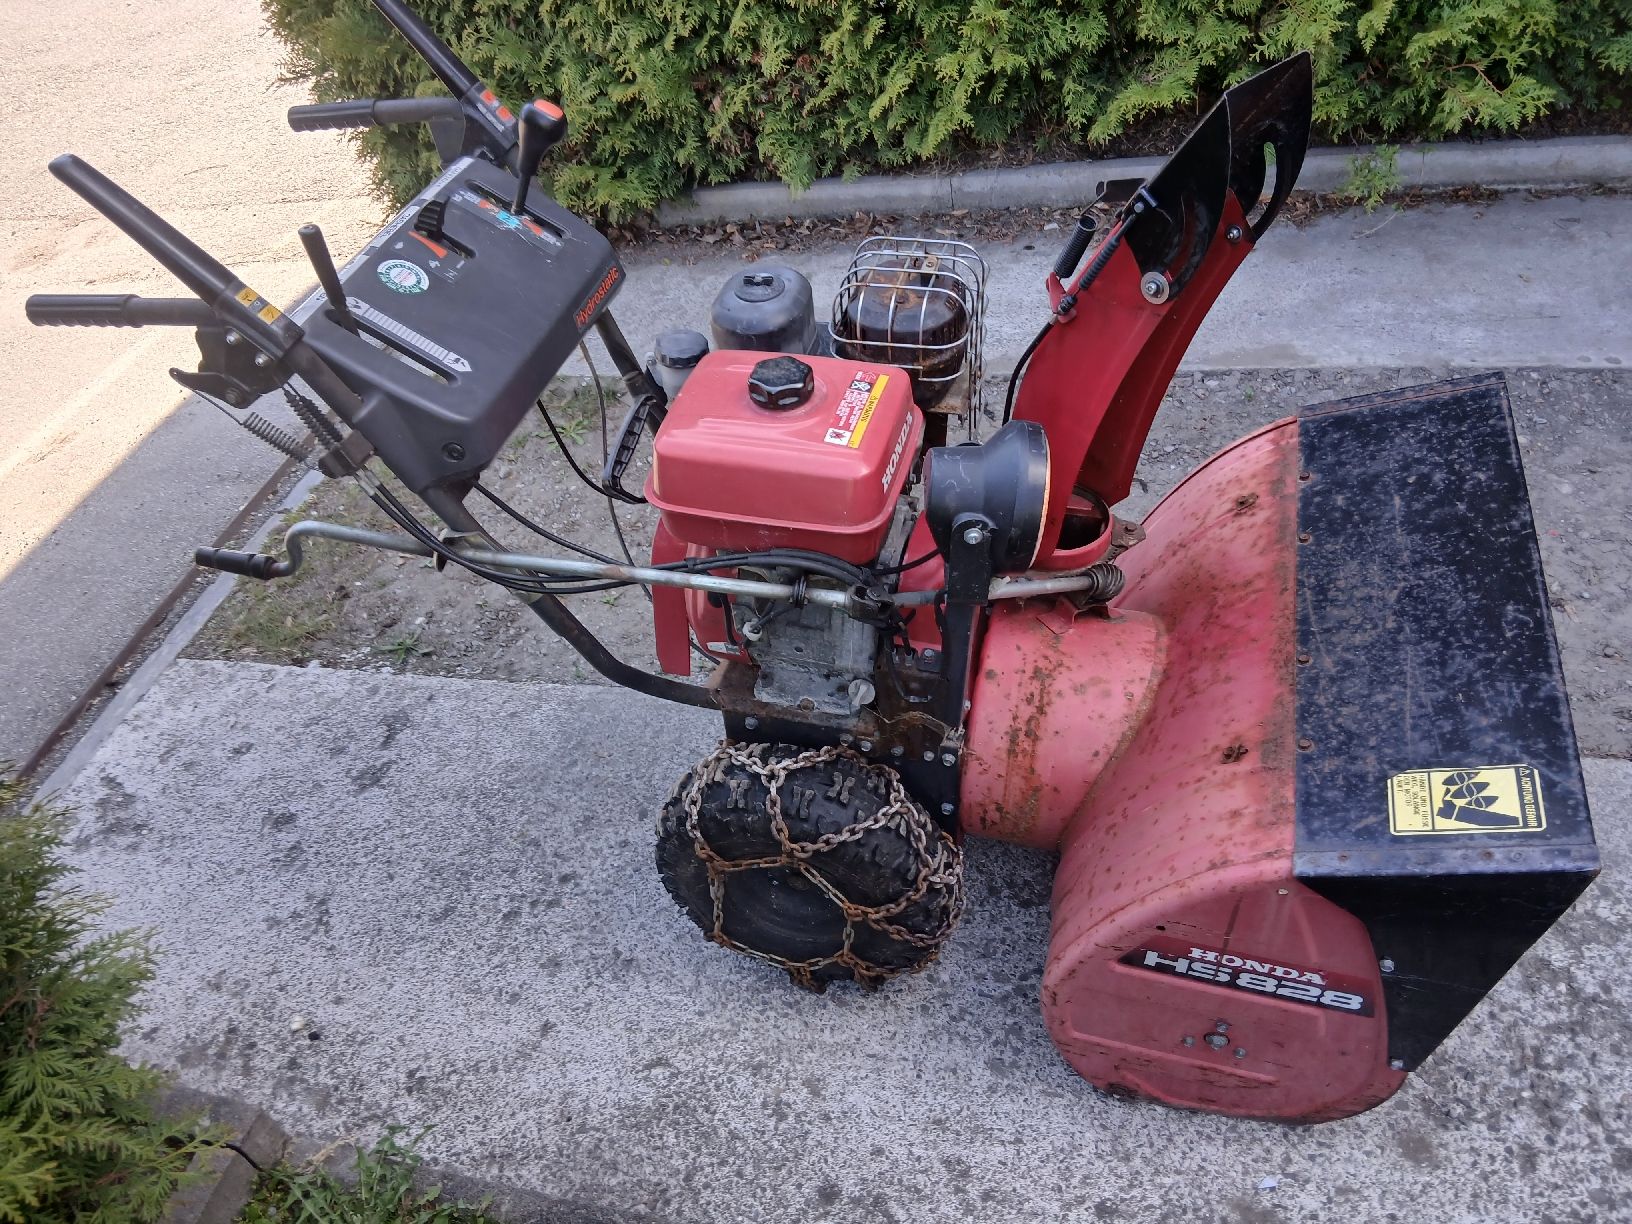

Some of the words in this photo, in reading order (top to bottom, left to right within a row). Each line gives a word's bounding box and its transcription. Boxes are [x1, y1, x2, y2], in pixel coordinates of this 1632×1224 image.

[576, 267, 619, 328] Hydrostatic
[882, 411, 913, 494] HONDA
[1520, 776, 1534, 804] ACHTUNG
[1188, 947, 1328, 985] HONDA
